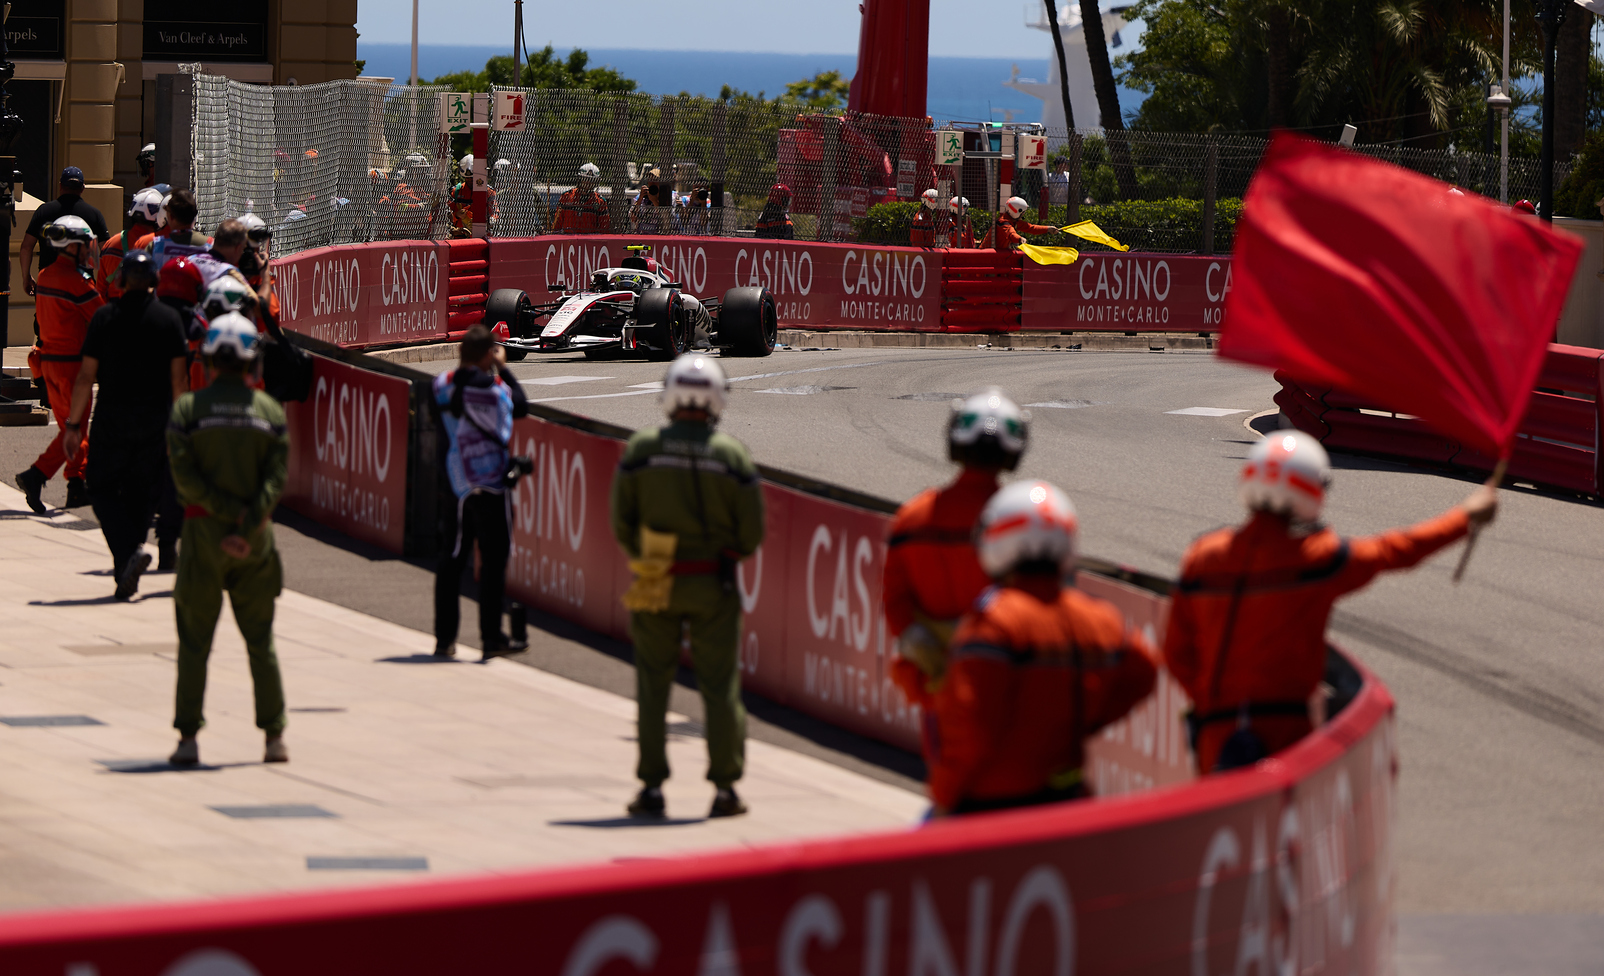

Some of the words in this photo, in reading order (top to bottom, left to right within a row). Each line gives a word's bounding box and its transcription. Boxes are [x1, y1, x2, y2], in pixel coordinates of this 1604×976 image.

[4, 28, 37, 43] rpels
[159, 31, 177, 44] Van
[180, 31, 207, 44] Cleef
[208, 35, 215, 44] &
[217, 33, 248, 48] Arpels
[312, 257, 361, 317] CASINO
[381, 250, 439, 307] CASINO
[734, 248, 813, 296] CASINO
[842, 250, 926, 298] CASINO
[1079, 257, 1171, 301] CASINO
[380, 312, 407, 335] MONTE
[411, 309, 438, 332] CARLO
[776, 302, 811, 320] CARLO
[841, 300, 880, 319] MONTE
[887, 303, 925, 322] CARLO
[1077, 305, 1119, 322] MONTE
[1127, 306, 1169, 323] CARLO
[333, 319, 358, 344] CARLO
[314, 375, 391, 483] CASINO
[312, 471, 347, 517] MONTE
[352, 487, 390, 532] CARLO
